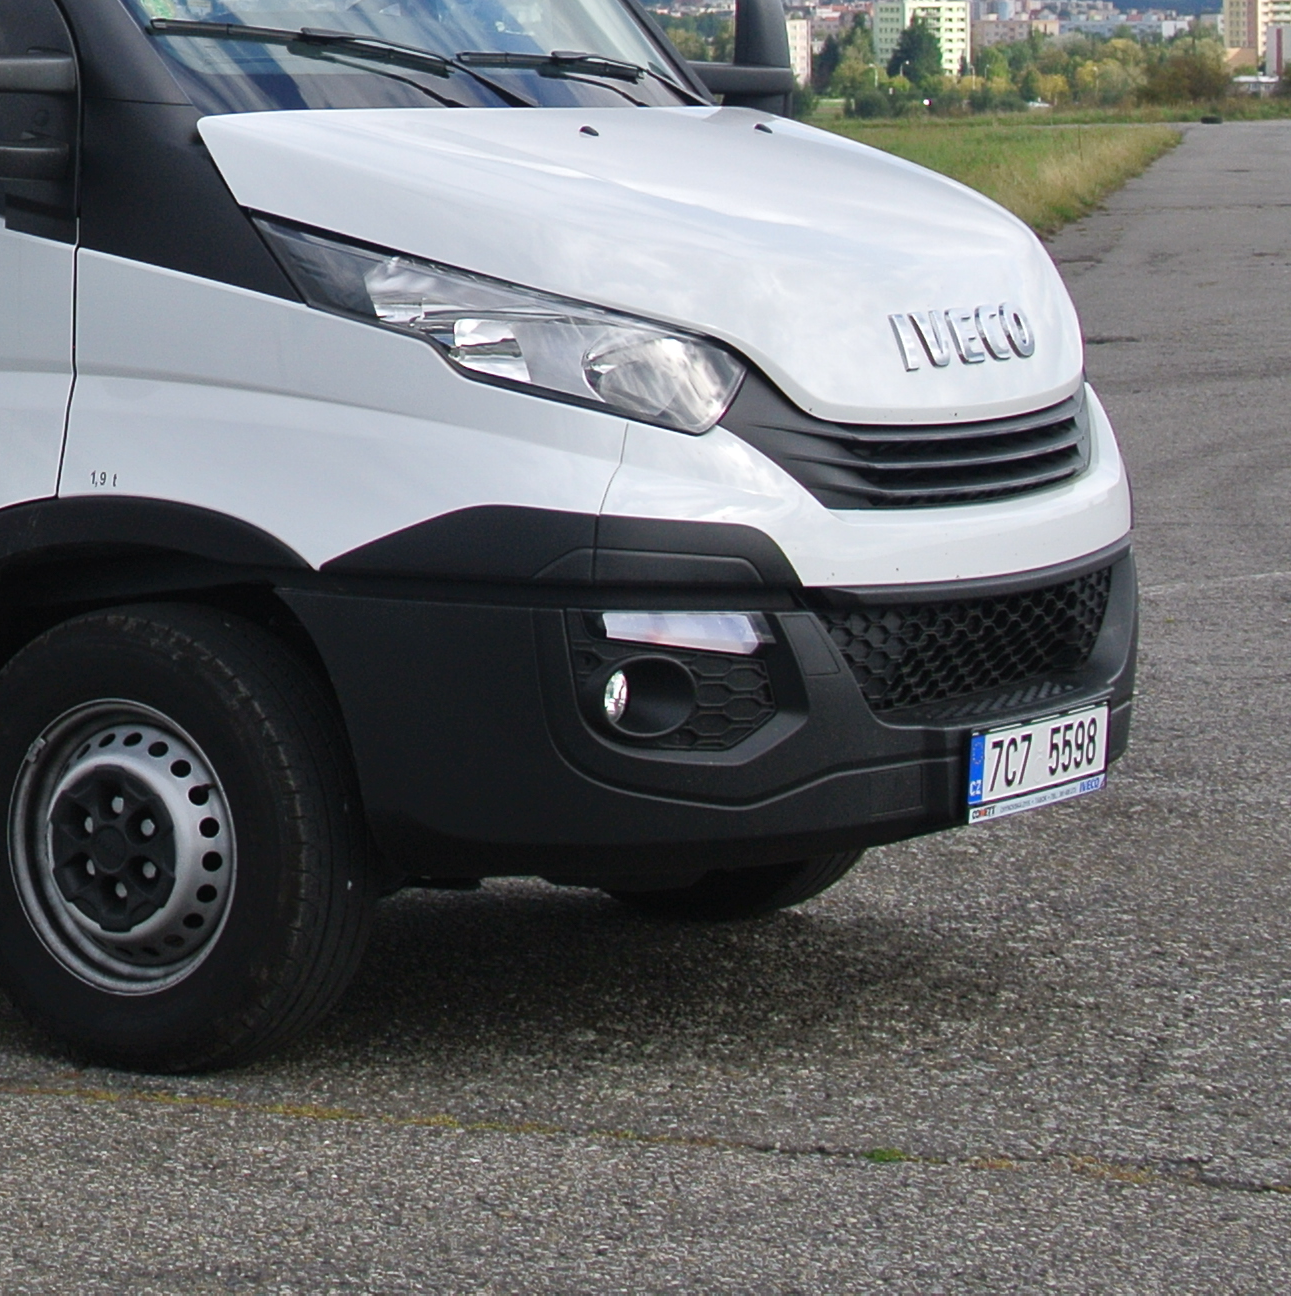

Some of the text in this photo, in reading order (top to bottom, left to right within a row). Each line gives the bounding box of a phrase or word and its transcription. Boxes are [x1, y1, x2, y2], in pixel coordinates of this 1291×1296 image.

[888, 303, 1035, 372] IVECO
[90, 470, 118, 488] 1,9 t
[989, 716, 1098, 793] 7C7 5598
[969, 779, 982, 796] CZ
[1079, 777, 1101, 793] IVECO
